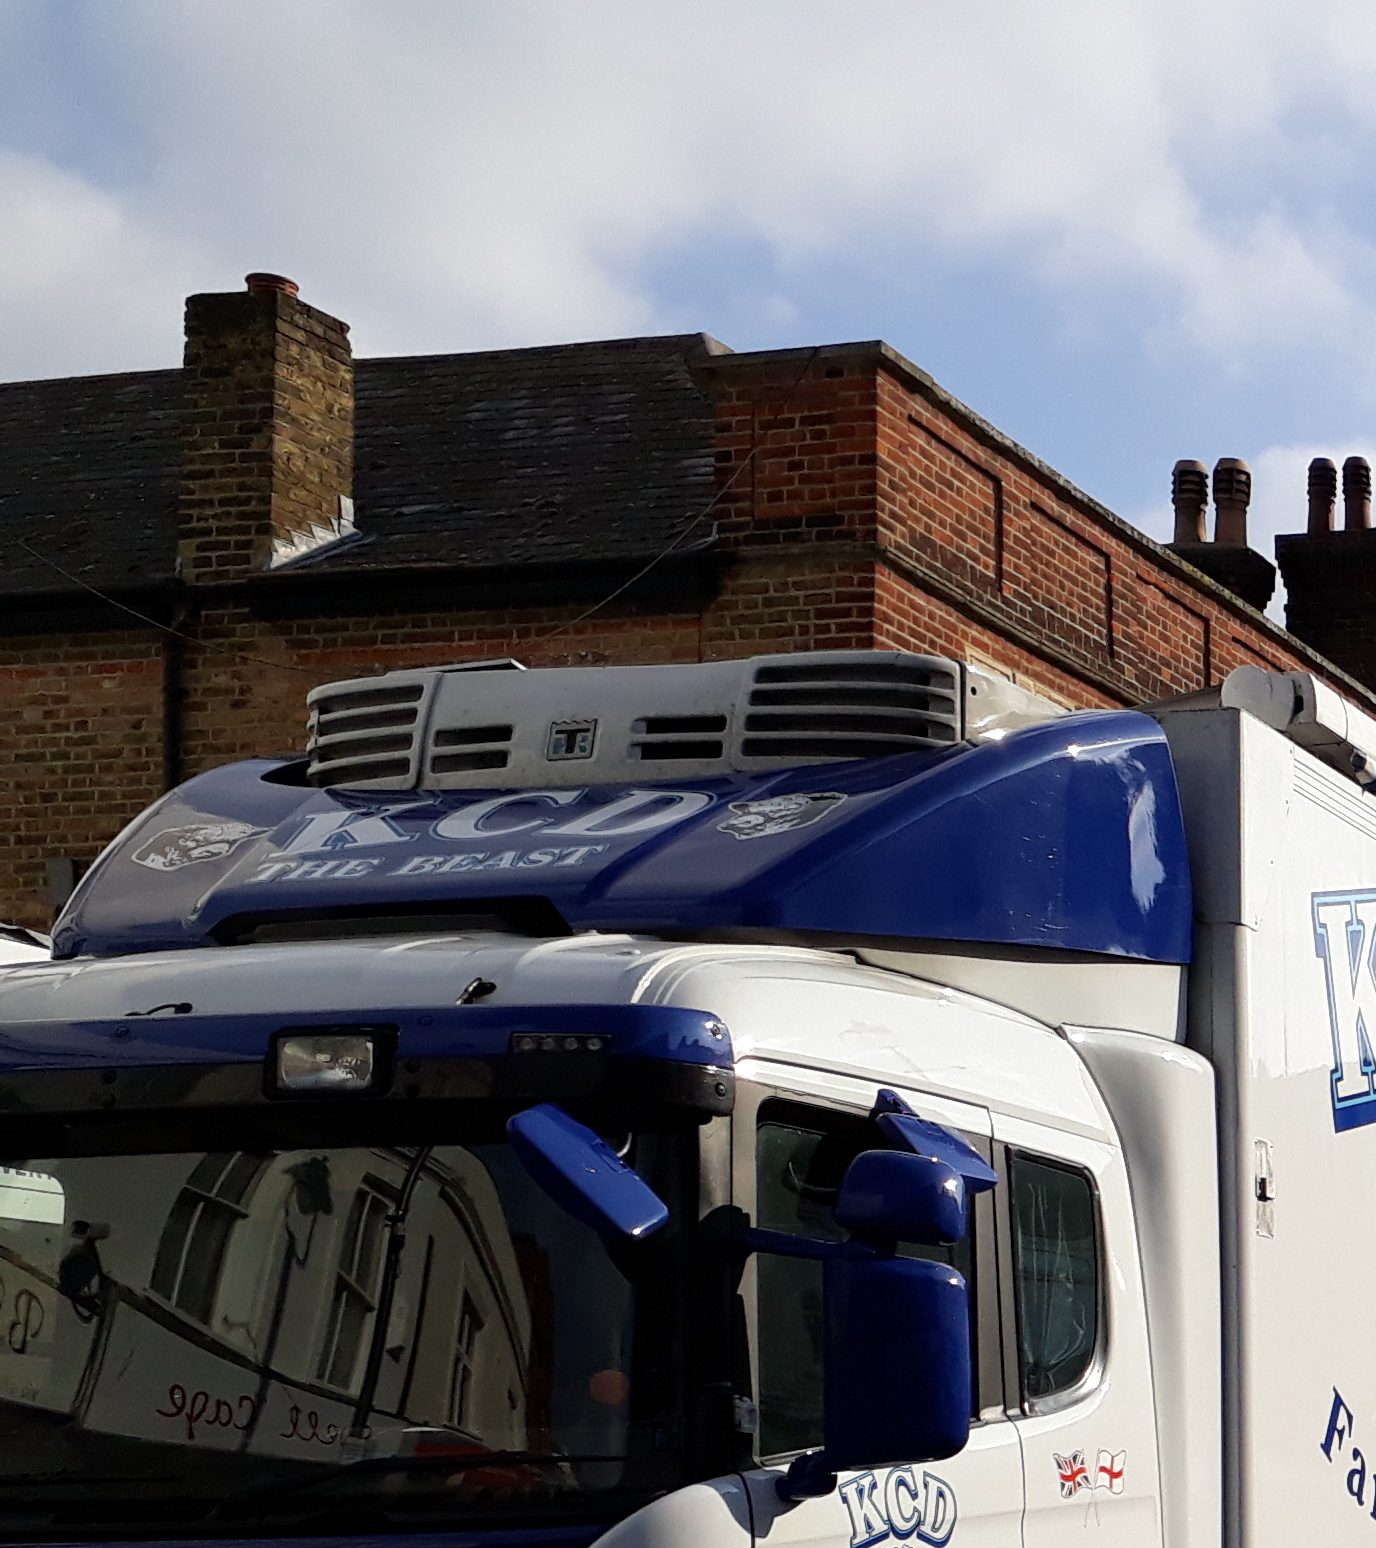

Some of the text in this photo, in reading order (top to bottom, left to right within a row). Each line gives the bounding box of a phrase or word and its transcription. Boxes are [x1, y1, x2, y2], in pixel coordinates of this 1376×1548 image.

[270, 786, 715, 858] KCD
[244, 843, 610, 884] THE BEAST
